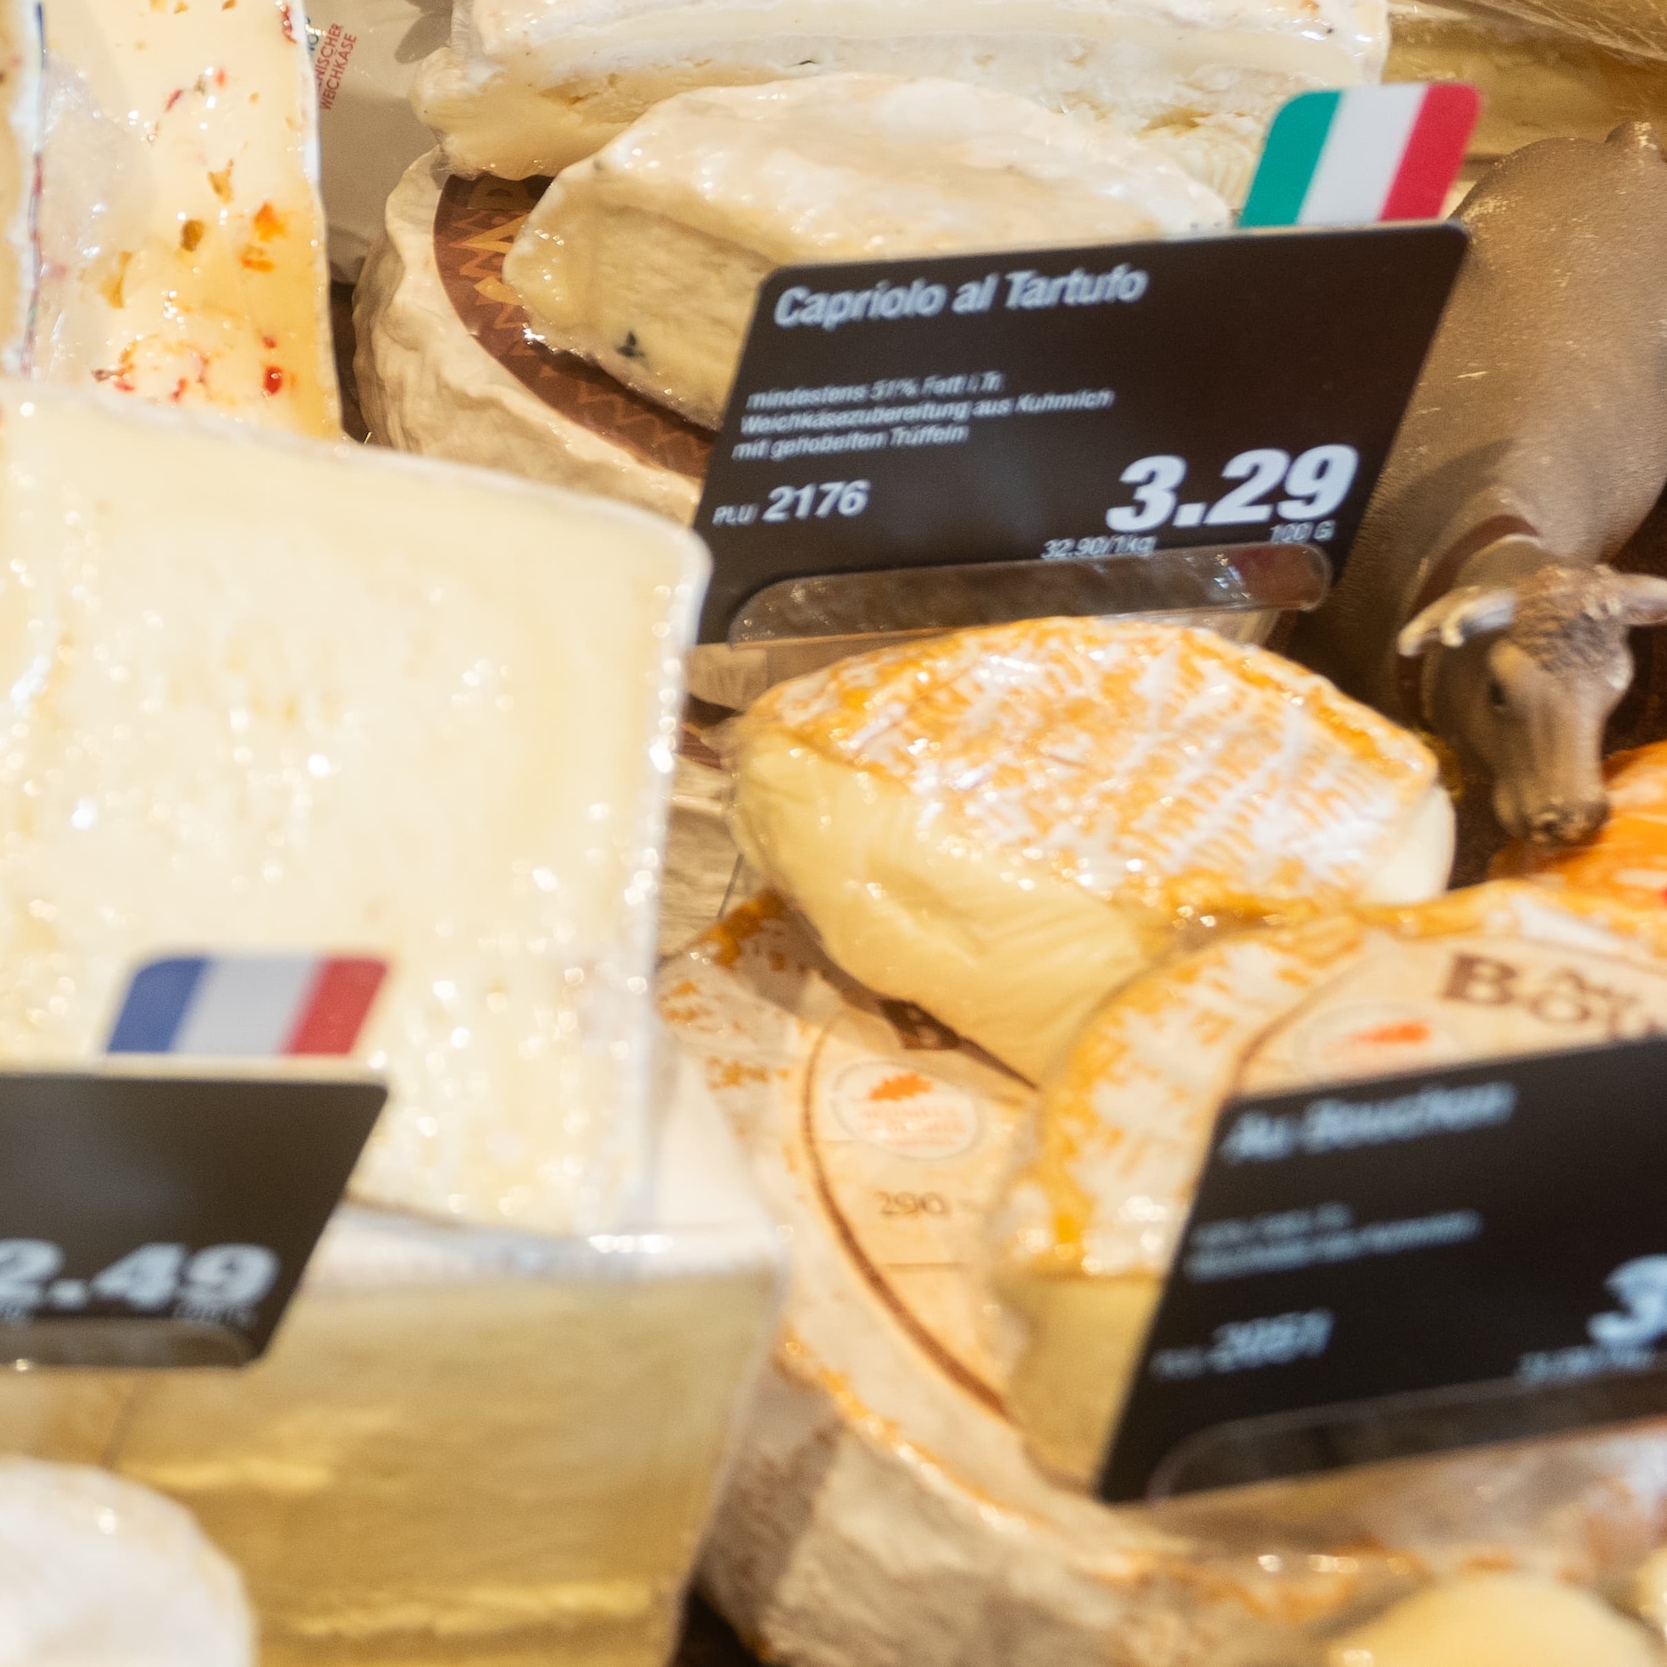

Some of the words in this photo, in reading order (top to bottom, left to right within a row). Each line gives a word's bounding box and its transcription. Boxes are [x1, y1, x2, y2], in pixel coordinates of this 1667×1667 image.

[319, 31, 358, 112] WEICHKÄSE
[774, 280, 948, 329] Capriolo
[951, 274, 999, 314] al
[1005, 264, 1148, 309] Tartufo
[712, 505, 754, 524] PLU
[762, 479, 871, 522] 2176
[1106, 444, 1360, 531] 3.29
[1040, 535, 1156, 563] 32.90/1kg
